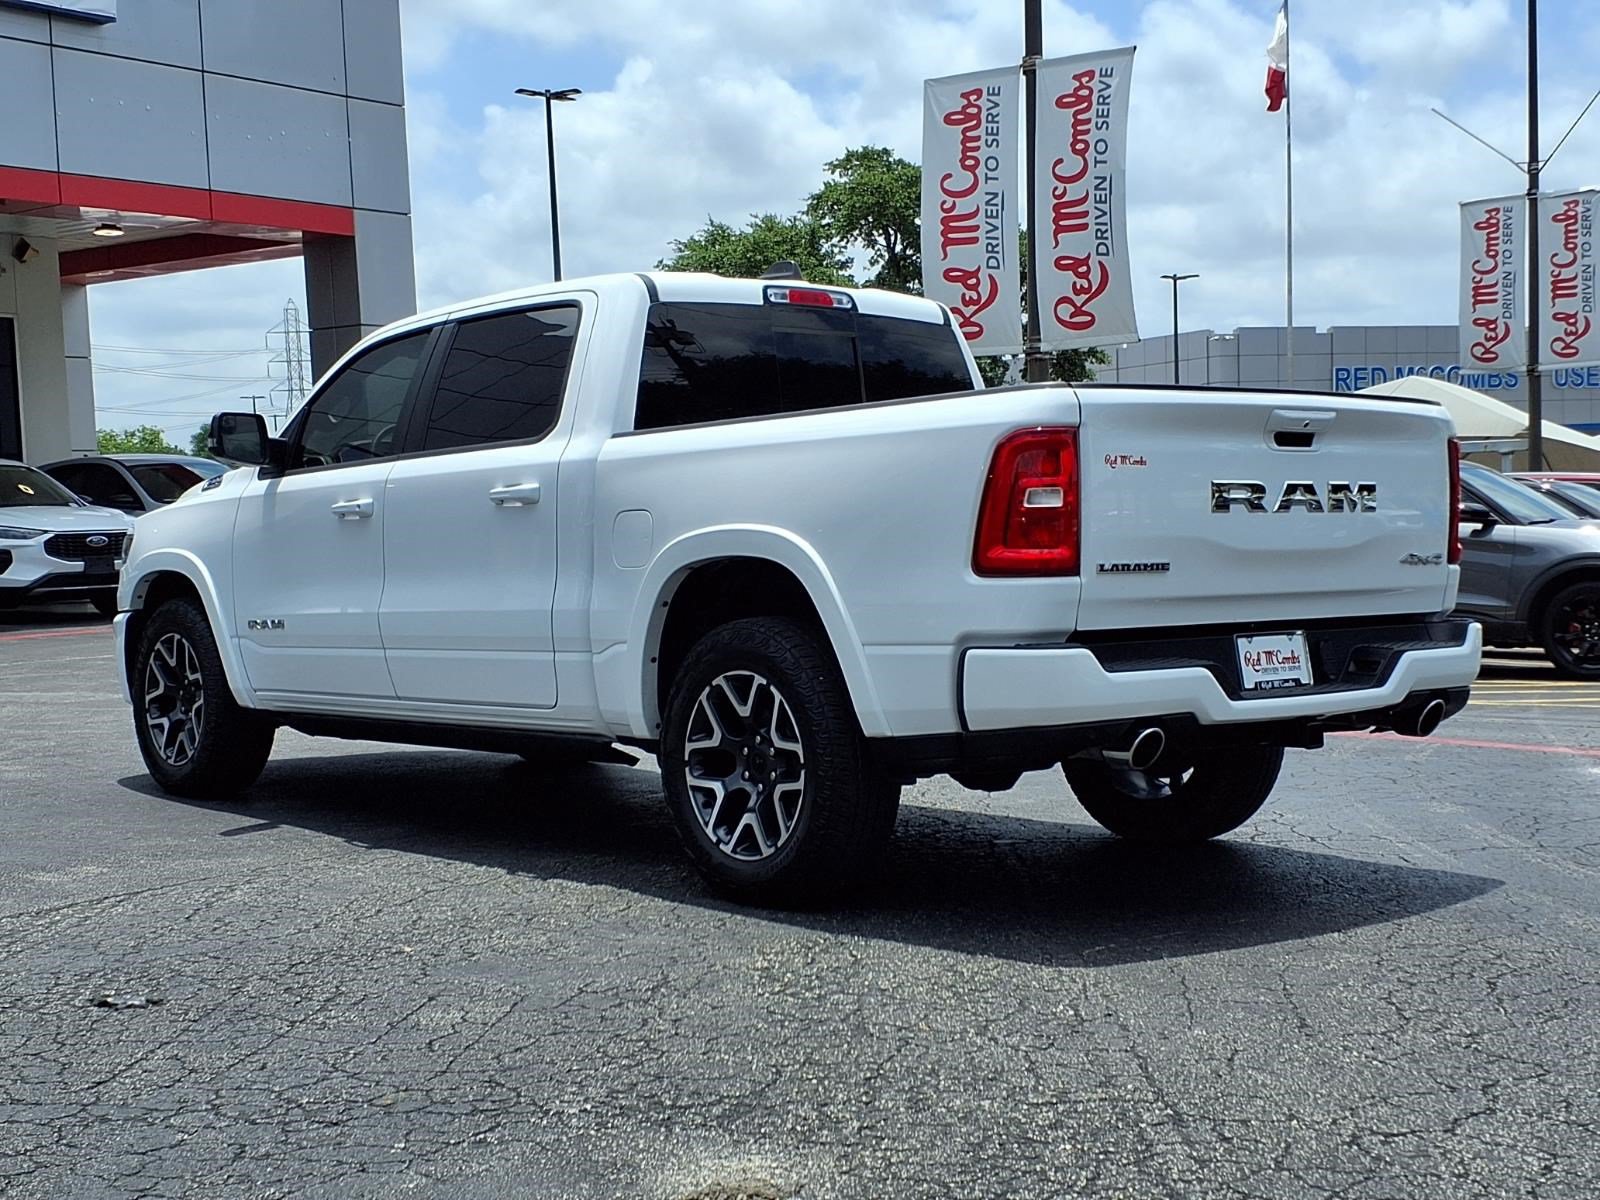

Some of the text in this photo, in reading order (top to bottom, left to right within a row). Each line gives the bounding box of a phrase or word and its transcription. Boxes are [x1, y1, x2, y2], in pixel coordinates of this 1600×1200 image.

[984, 85, 1001, 270] DRIVEN TO SERVE
[1094, 66, 1114, 257] DRIVEN TO SERVE
[1502, 205, 1513, 319] DRIVEN TO SERVE
[1581, 199, 1593, 313] DRIVEN TO SERVE
[943, 265, 999, 341] Red
[1053, 252, 1110, 331] Red
[1470, 317, 1511, 363] Red
[1550, 311, 1591, 358] Red
[1334, 366, 1387, 392] RED
[1104, 454, 1118, 469] Red
[1210, 479, 1377, 513] RAM
[1097, 562, 1170, 573] LARAMIE
[248, 619, 285, 630] RAM
[1244, 650, 1262, 672] Red
